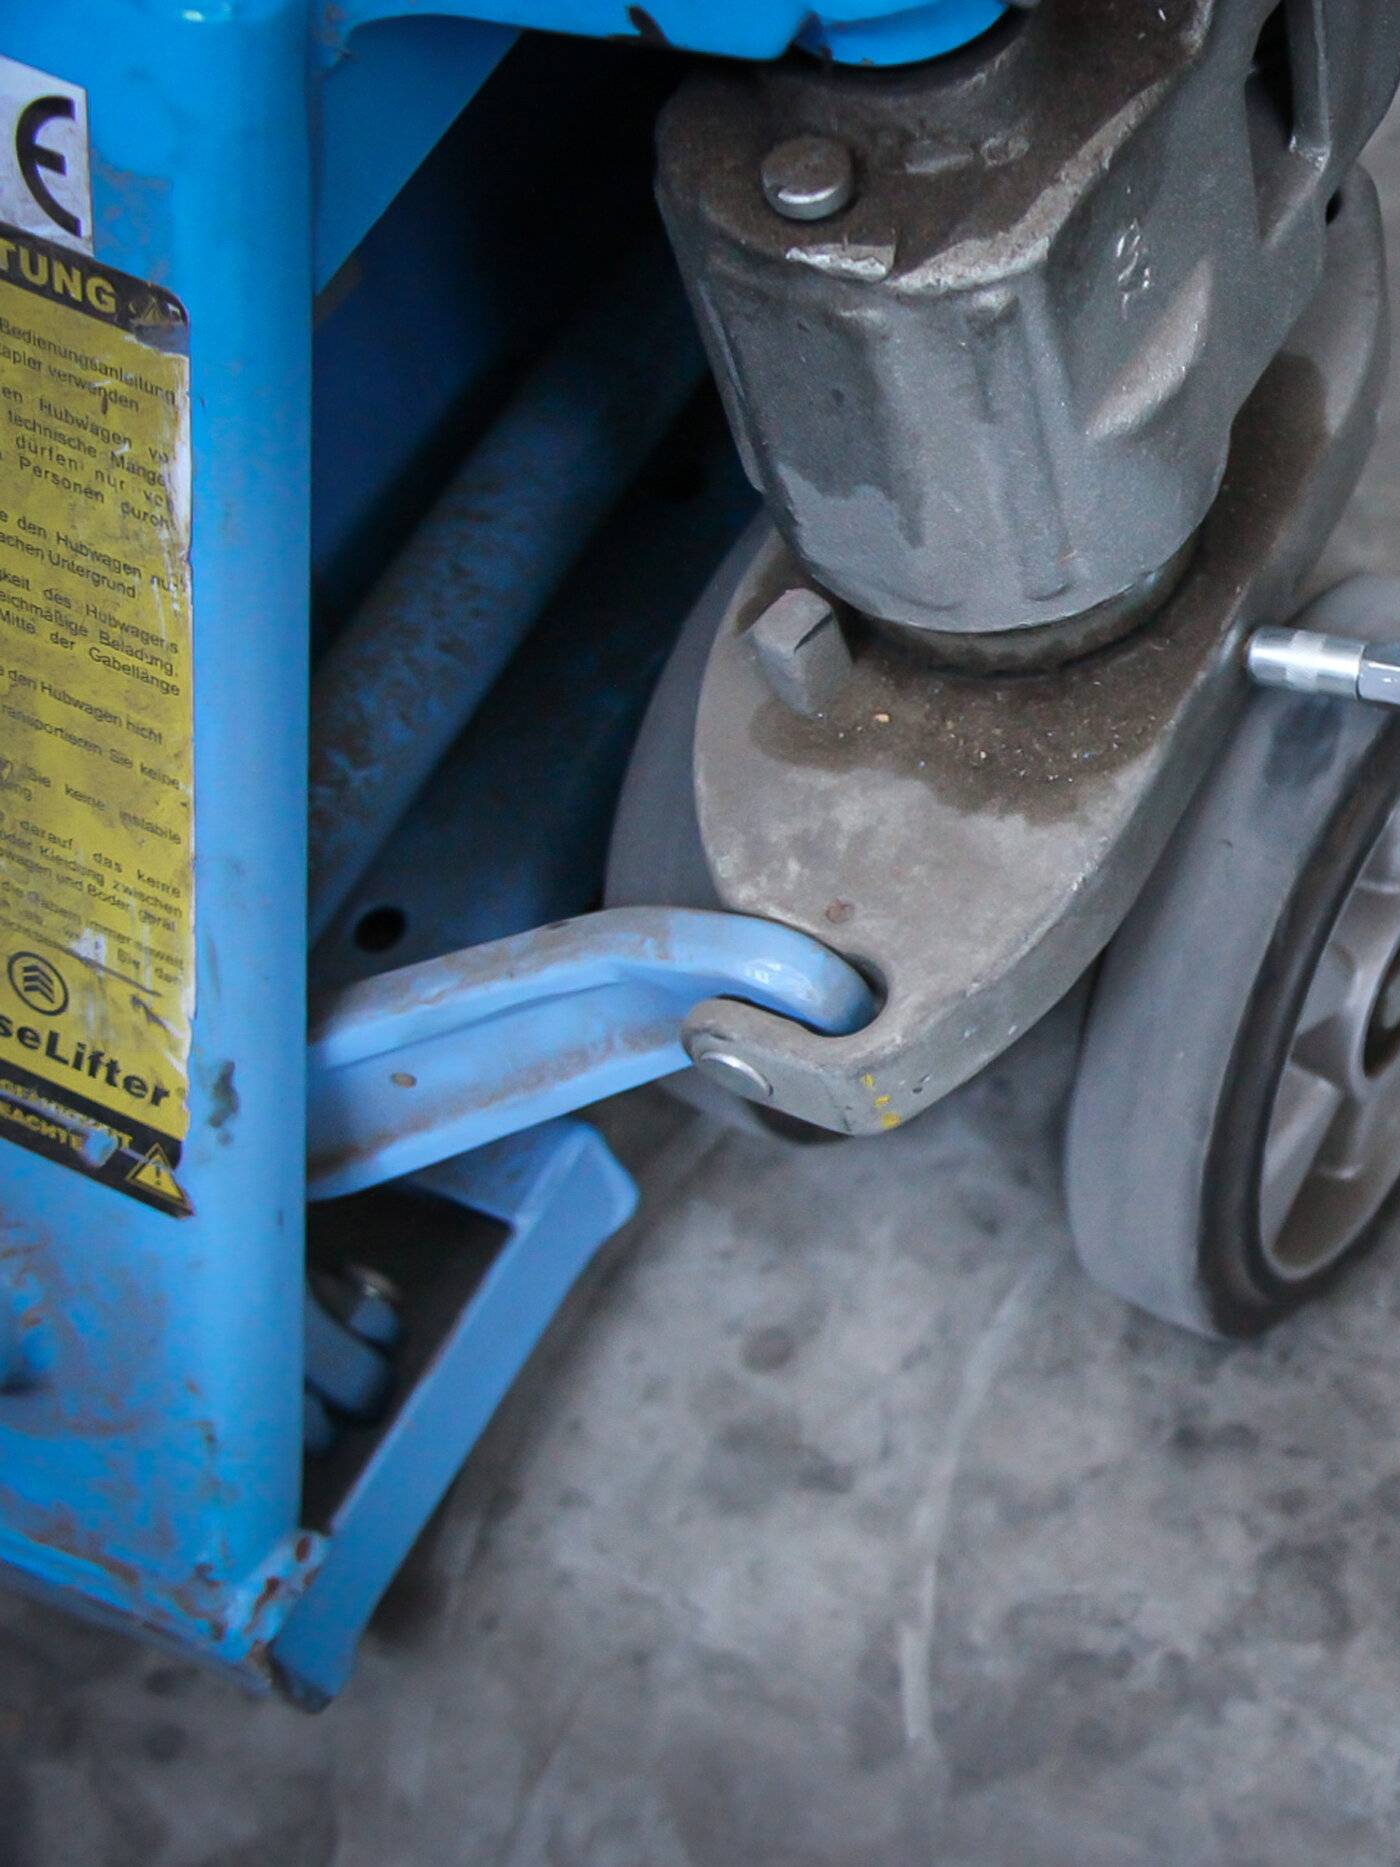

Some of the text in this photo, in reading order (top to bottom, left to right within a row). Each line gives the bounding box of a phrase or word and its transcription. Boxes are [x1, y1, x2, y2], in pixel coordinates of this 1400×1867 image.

[0, 237, 117, 314] TUNG
[39, 397, 132, 449] Hubwagen
[19, 456, 105, 504] Personen
[49, 550, 136, 599] Untergrund
[56, 531, 142, 579] Hubwagen
